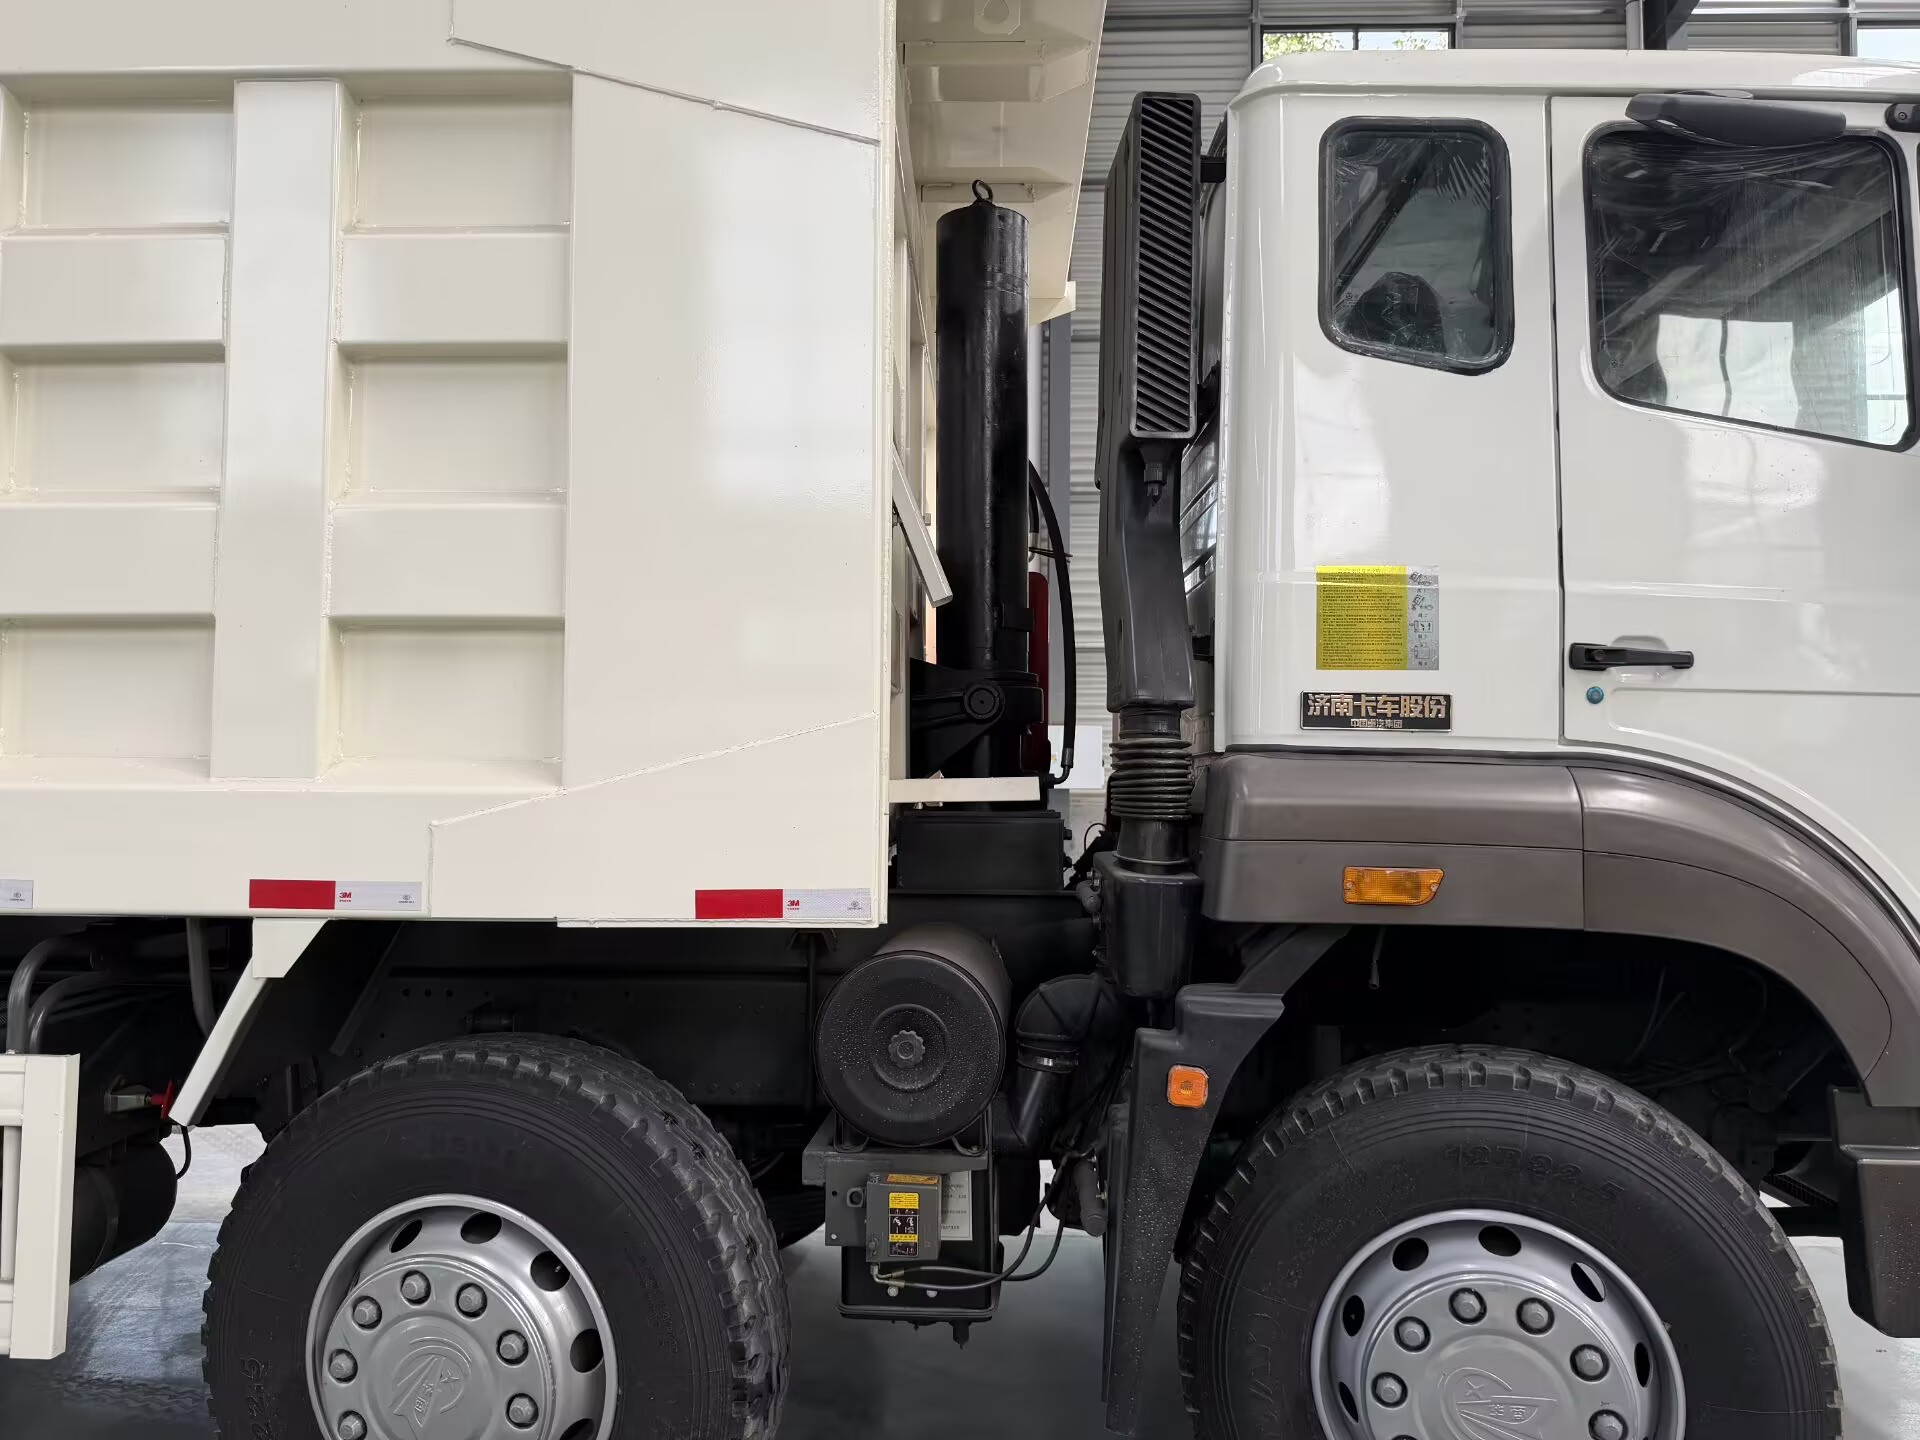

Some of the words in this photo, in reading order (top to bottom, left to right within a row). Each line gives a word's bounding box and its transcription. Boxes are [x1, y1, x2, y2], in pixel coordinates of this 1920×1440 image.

[1307, 693, 1447, 719] 济南卡车股份
